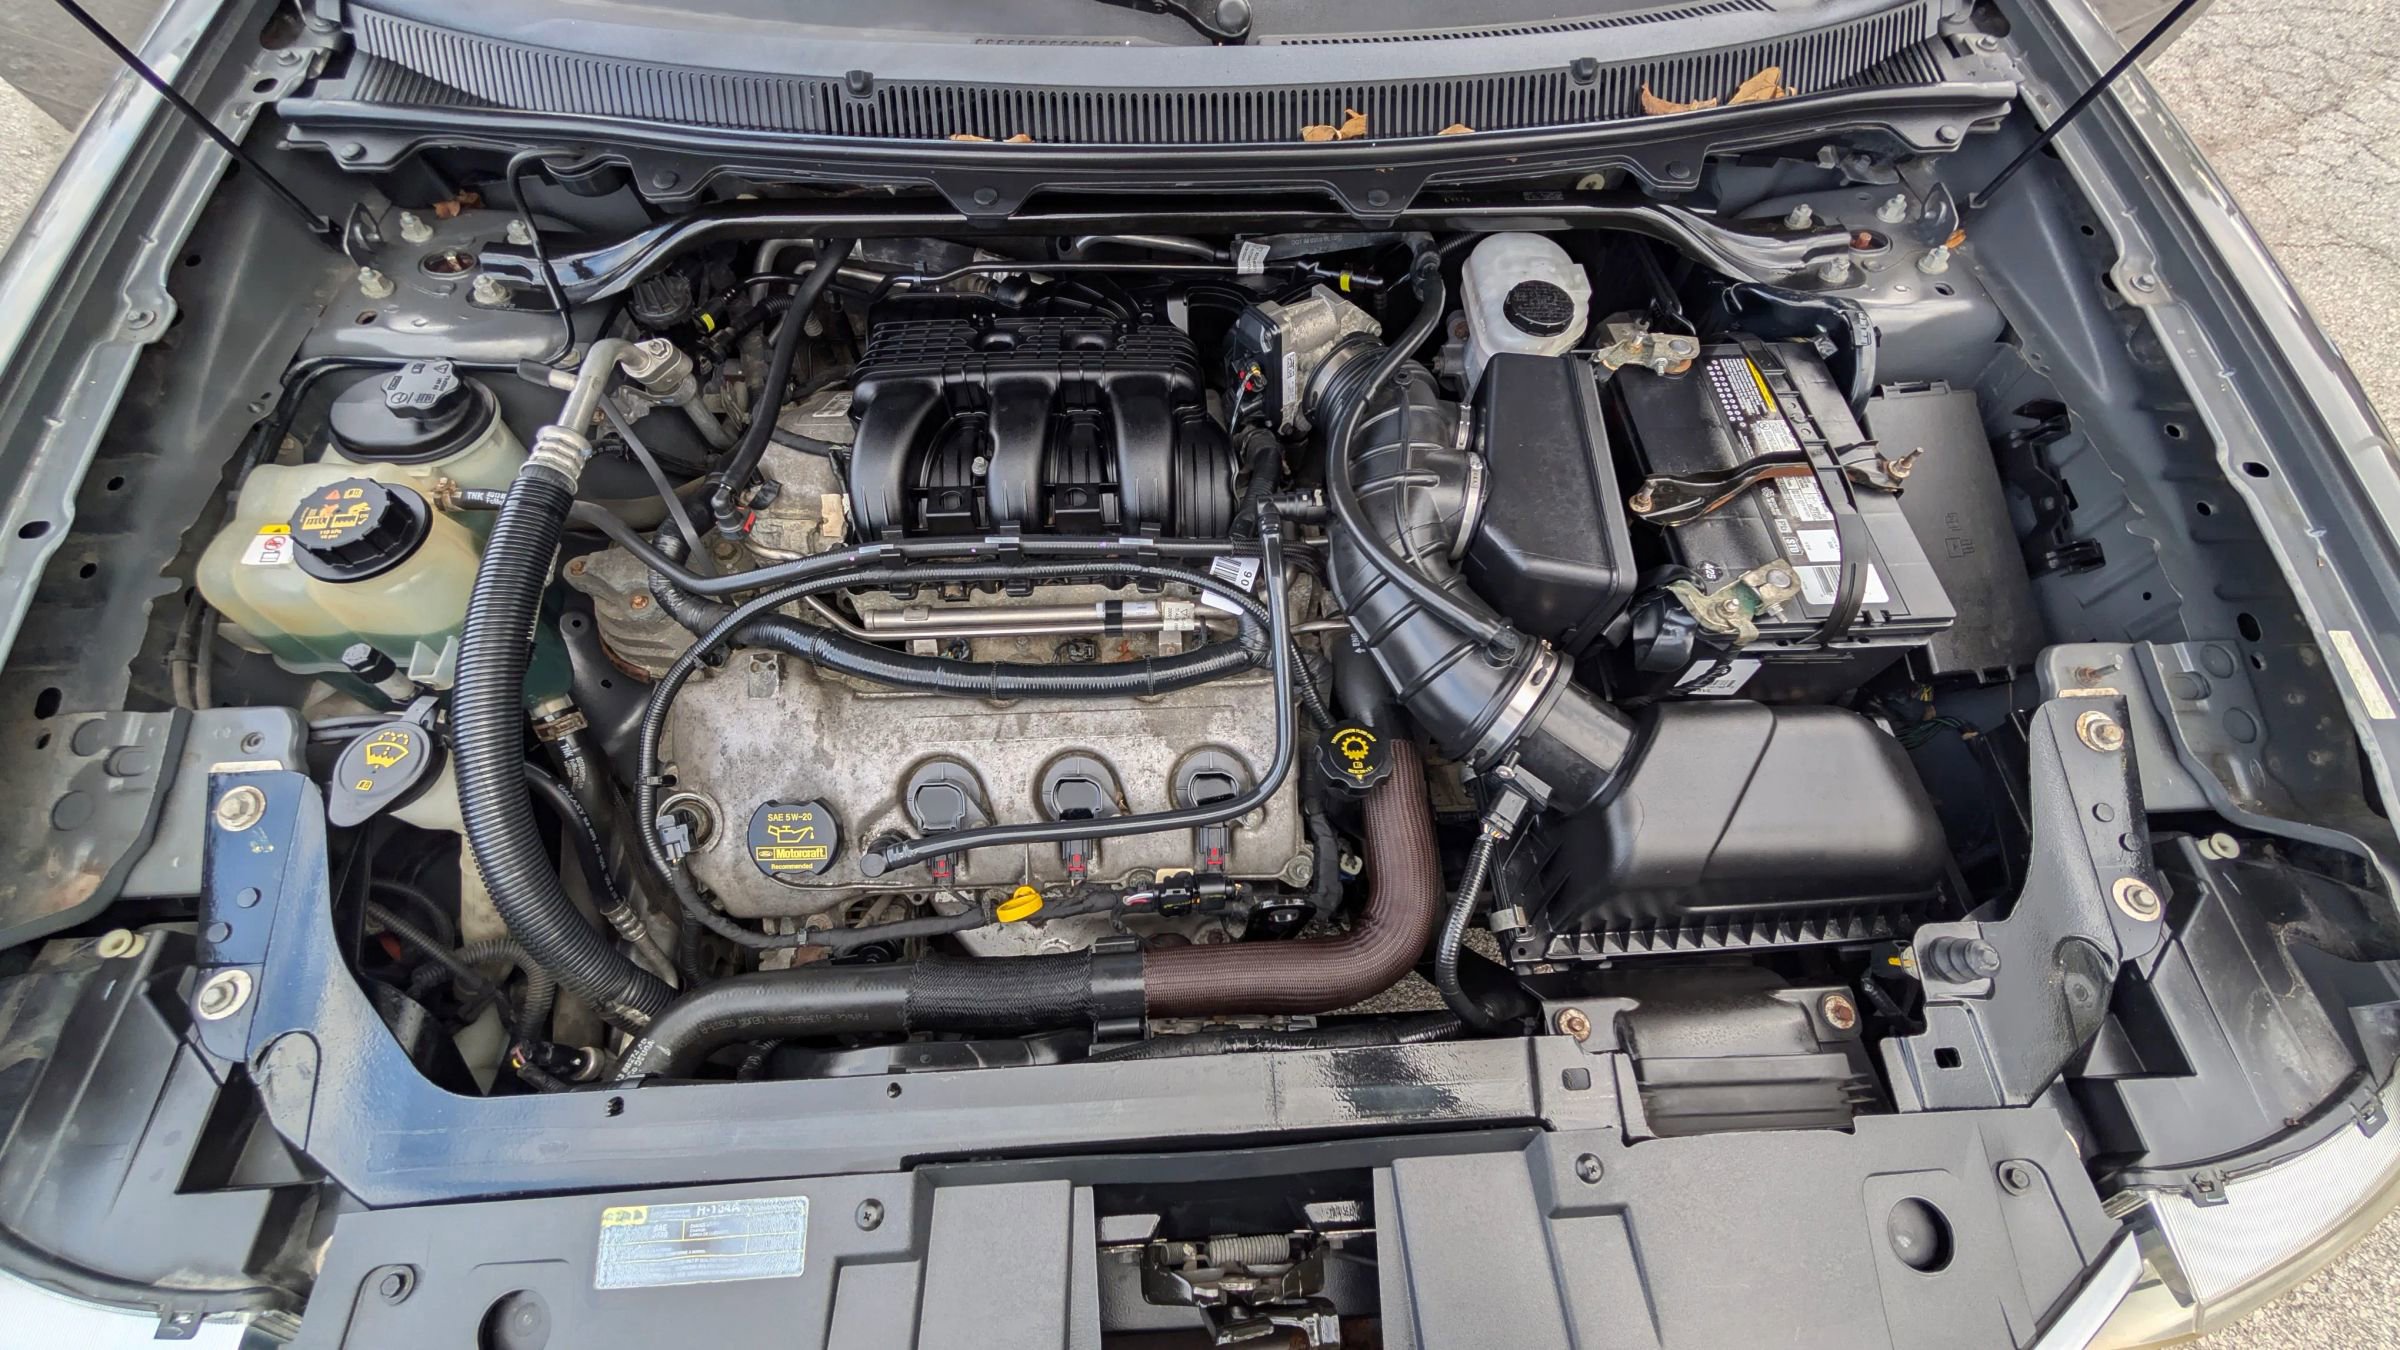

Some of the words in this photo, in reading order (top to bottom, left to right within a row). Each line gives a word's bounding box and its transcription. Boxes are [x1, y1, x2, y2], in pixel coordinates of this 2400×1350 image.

[768, 813, 784, 822] SAE
[785, 812, 813, 821] 5W-20
[776, 848, 825, 859] Motorcraft
